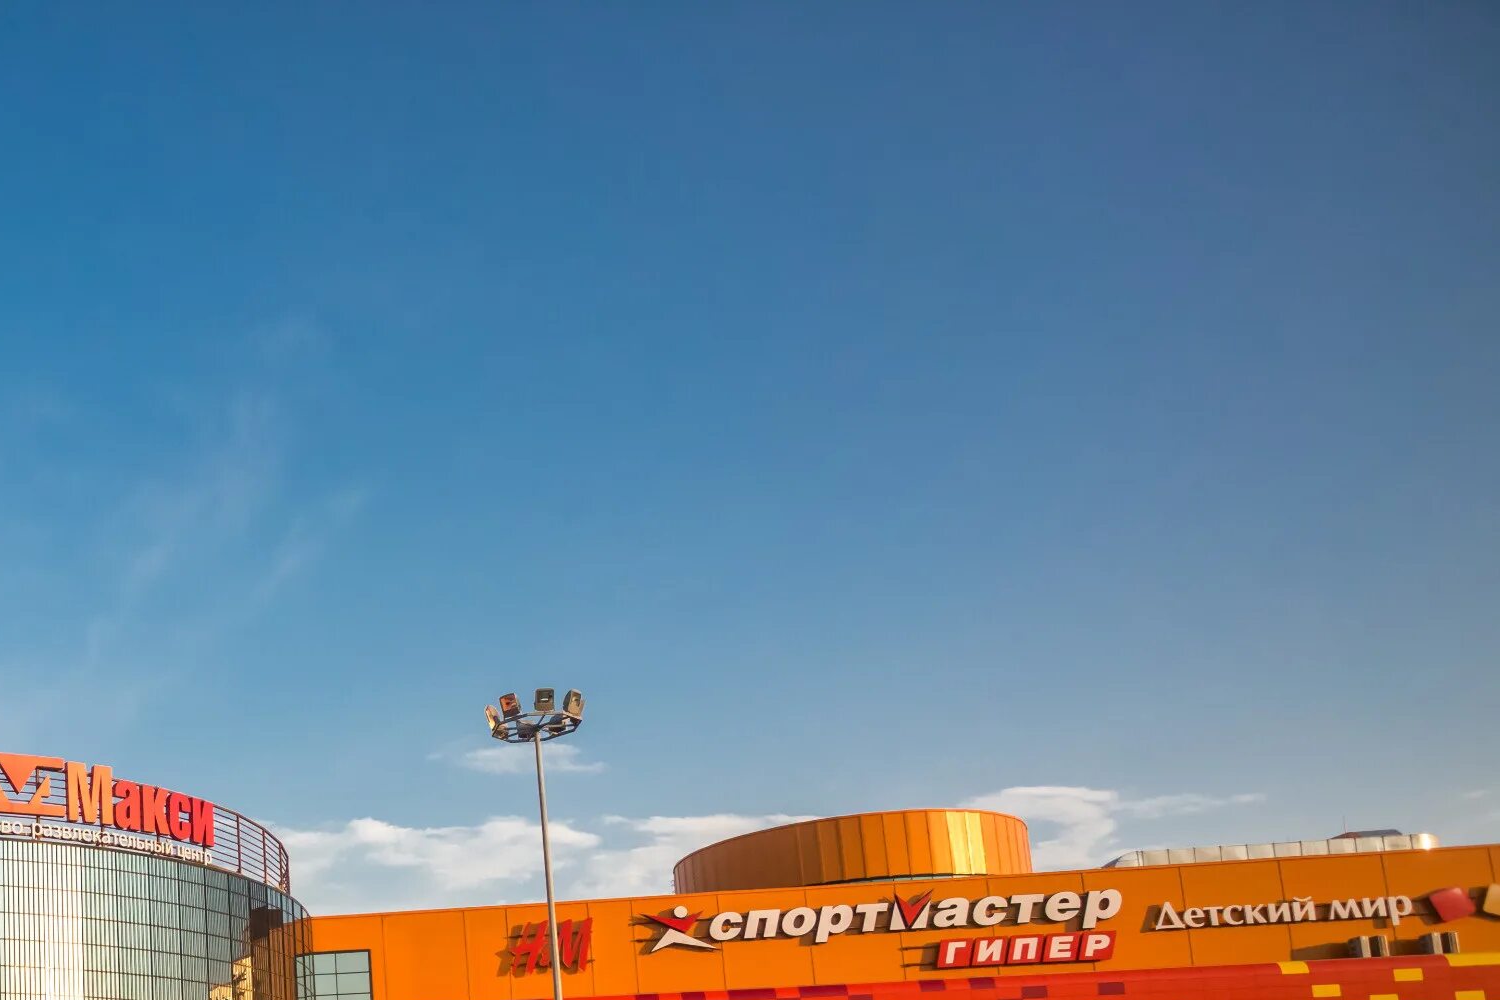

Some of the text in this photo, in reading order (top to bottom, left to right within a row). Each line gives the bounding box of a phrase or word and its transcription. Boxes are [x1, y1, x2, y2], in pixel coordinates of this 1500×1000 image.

[65, 761, 214, 847] Макси
[177, 845, 213, 865] центр
[1155, 895, 1412, 930] Детский мир
[944, 934, 1111, 964] ГИПЕР
